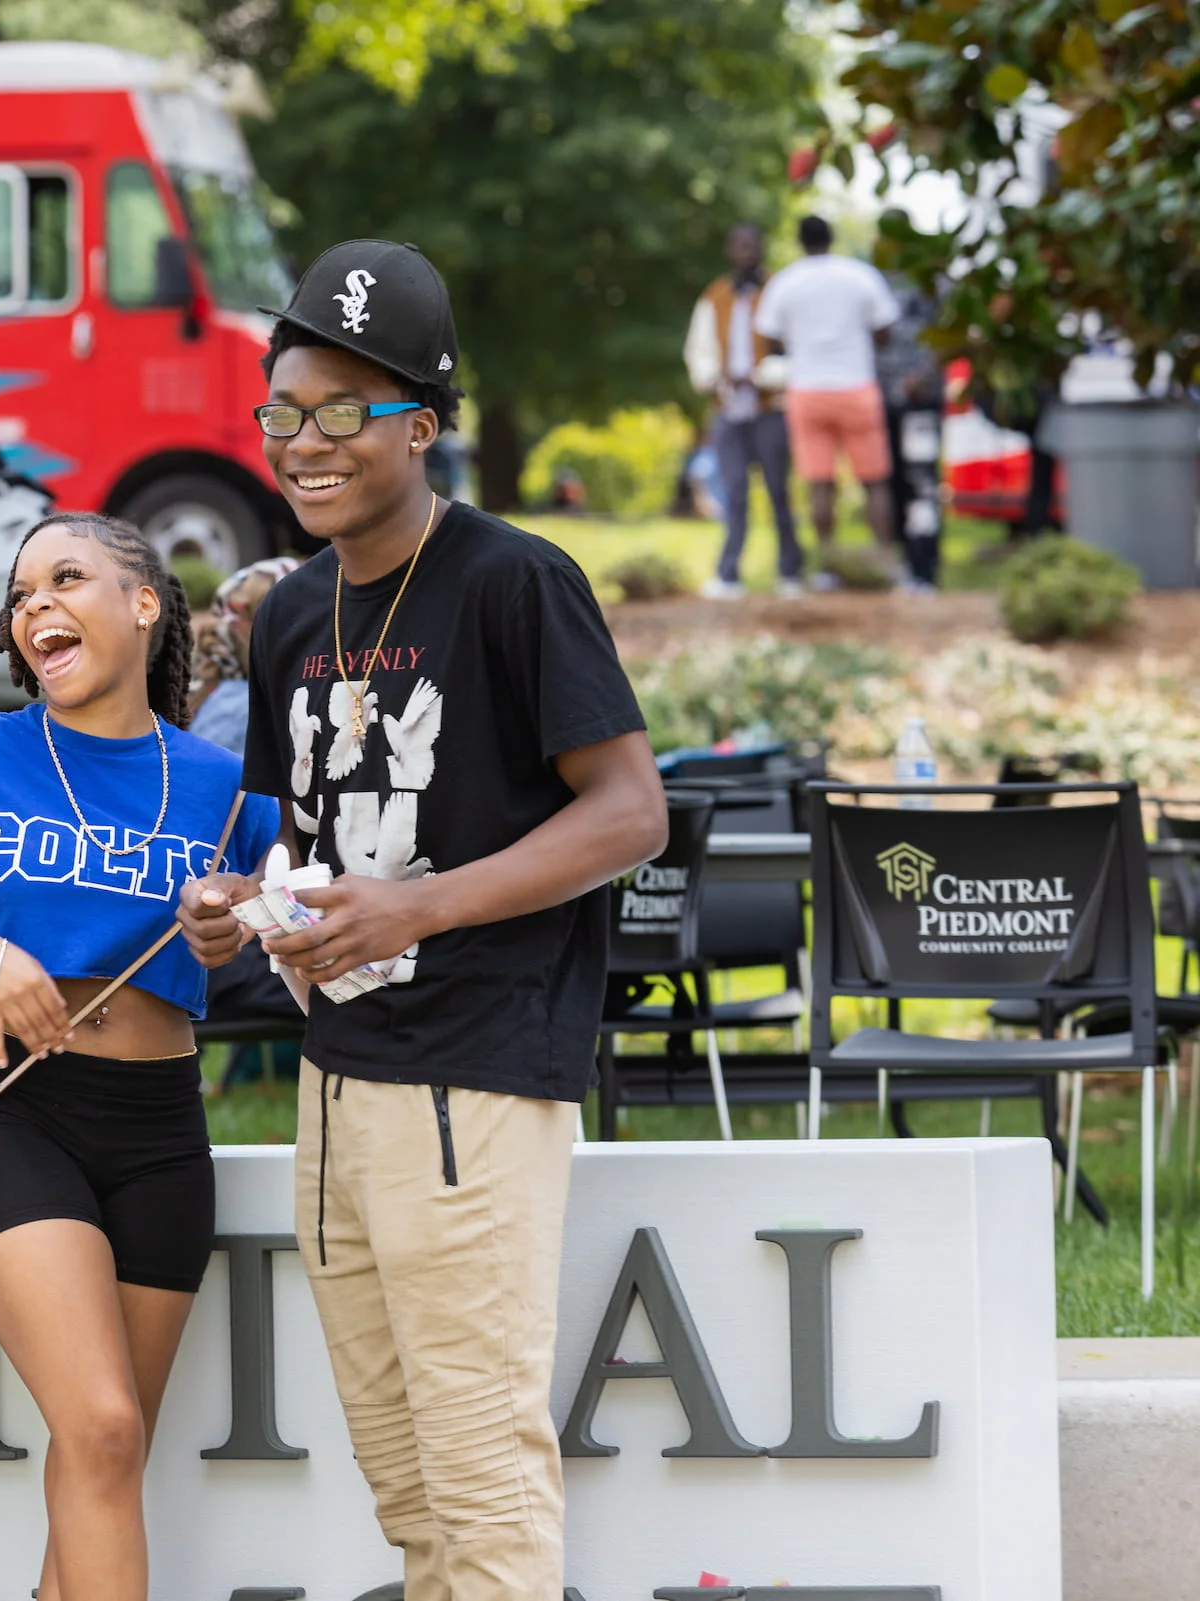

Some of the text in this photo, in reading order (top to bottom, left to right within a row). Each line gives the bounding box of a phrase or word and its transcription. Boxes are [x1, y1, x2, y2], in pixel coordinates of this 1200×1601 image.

[932, 874, 1074, 905] CENTRAL
[917, 905, 1075, 937] PIEDMONT
[918, 941, 1006, 954] COMMUNITY
